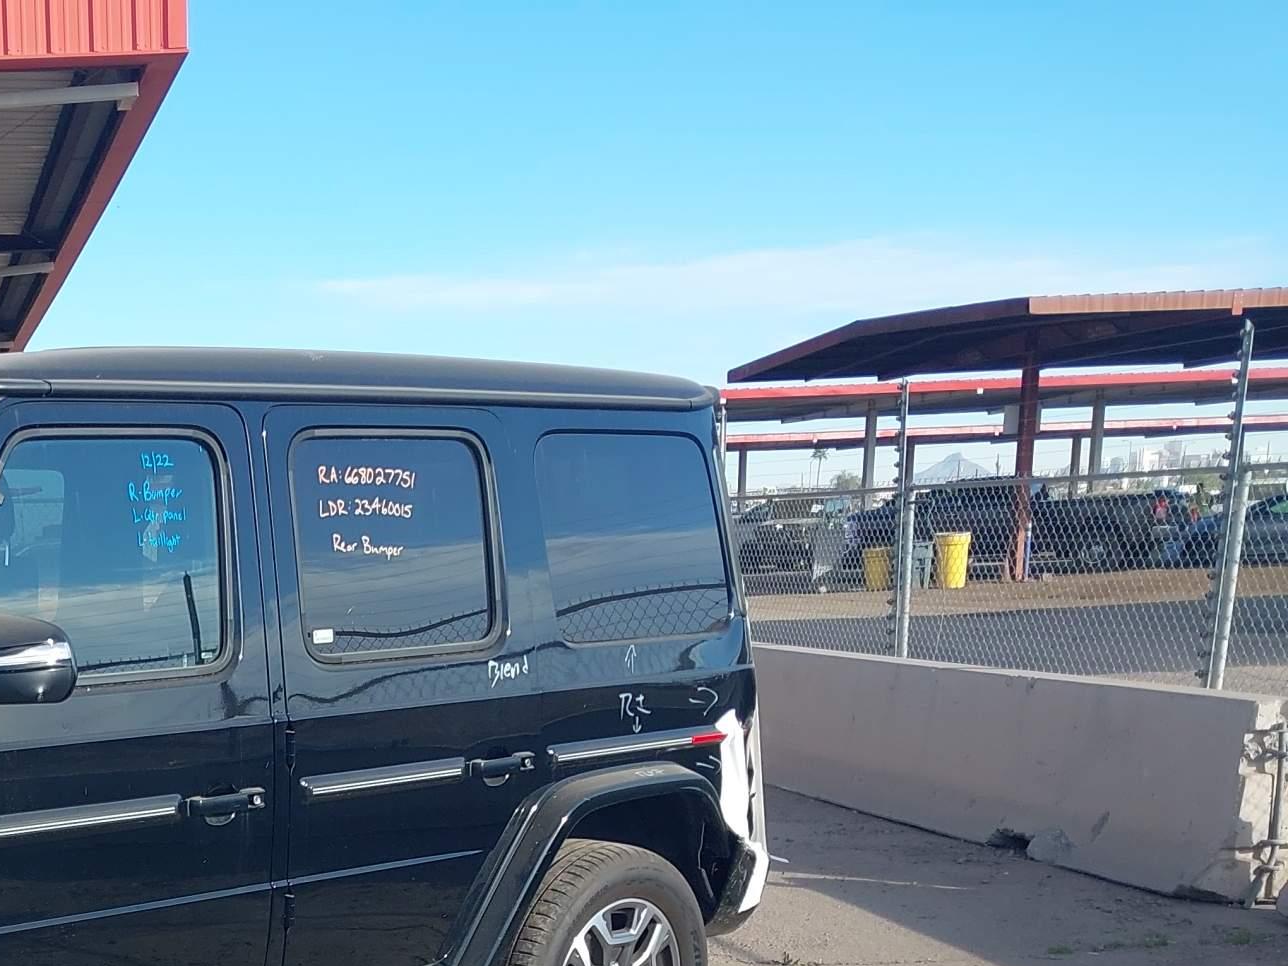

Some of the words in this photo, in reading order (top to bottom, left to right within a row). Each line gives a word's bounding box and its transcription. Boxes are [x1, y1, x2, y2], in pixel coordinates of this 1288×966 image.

[140, 451, 174, 474] 12/22
[354, 496, 414, 519] 23460015
[332, 533, 358, 554] Rear
[361, 535, 405, 561] Bumper
[487, 654, 530, 688] Blend
